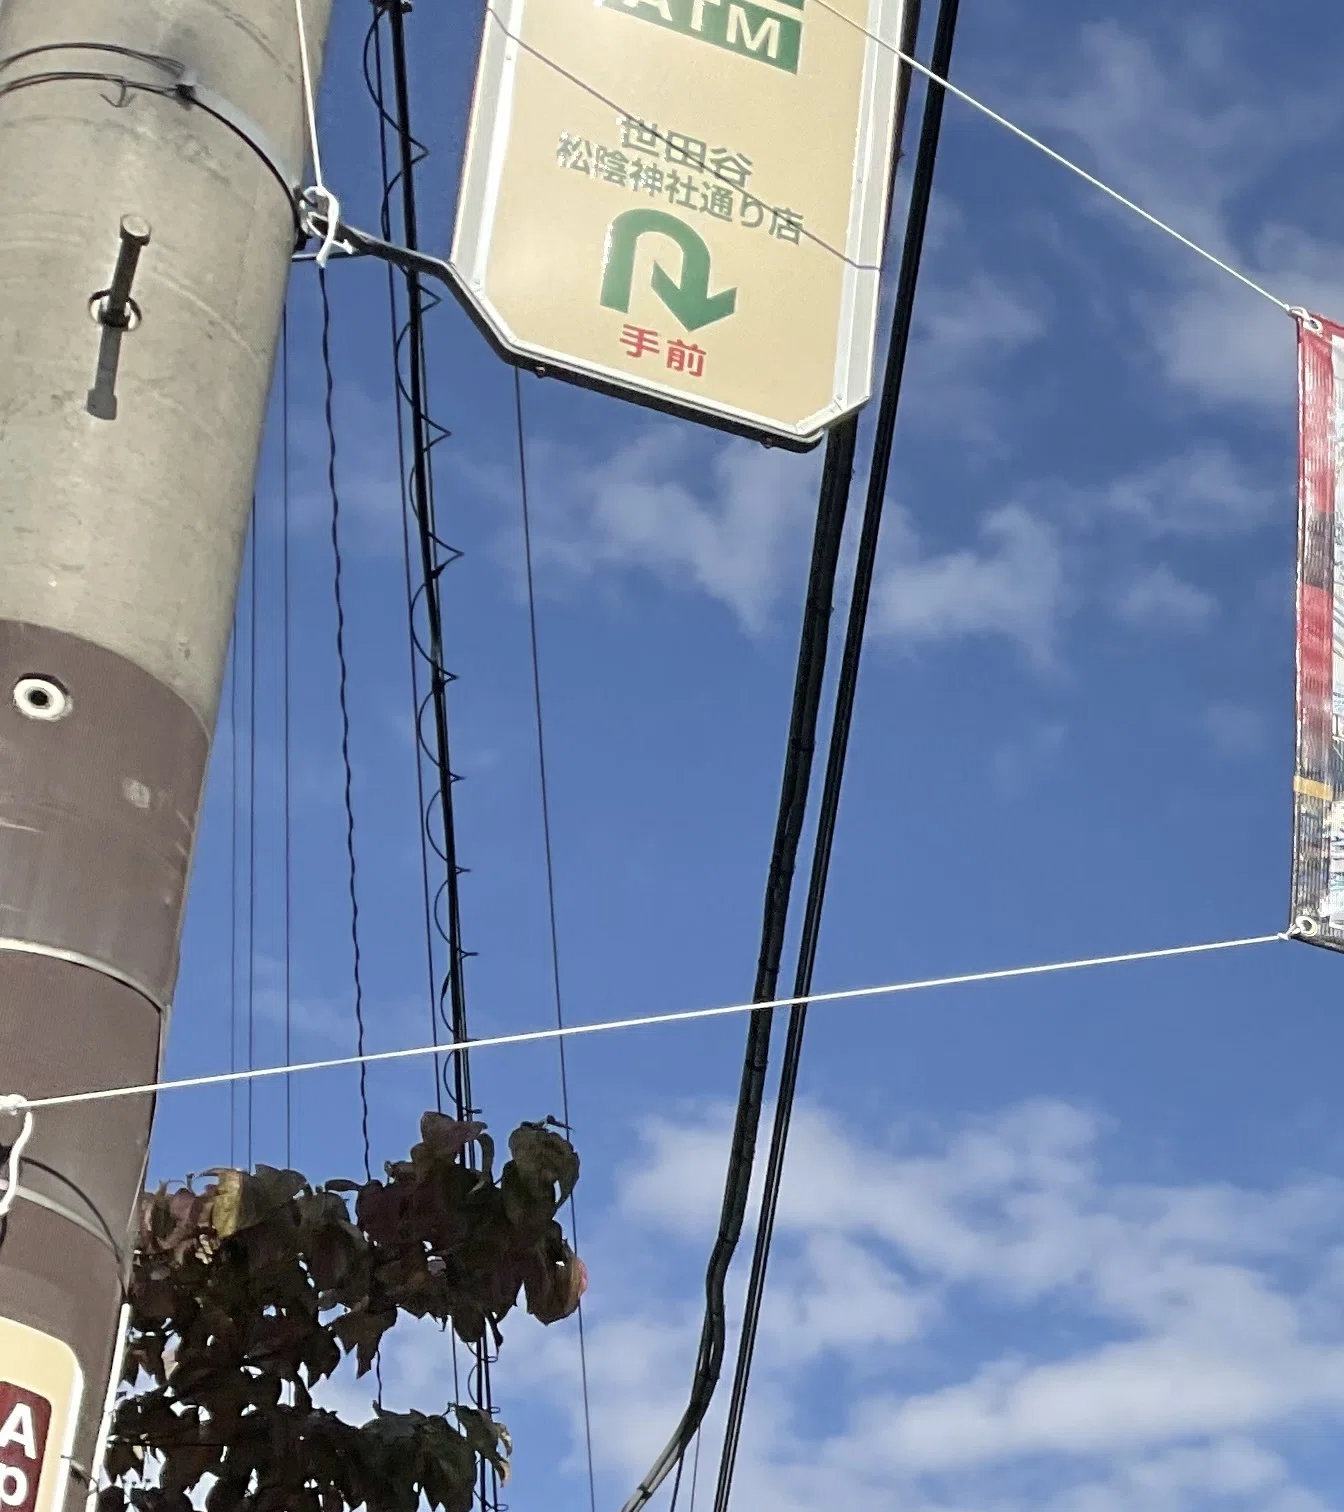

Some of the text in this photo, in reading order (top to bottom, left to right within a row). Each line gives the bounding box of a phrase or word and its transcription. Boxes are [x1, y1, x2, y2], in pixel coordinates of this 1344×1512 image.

[556, 130, 804, 246] 松陰神社通り店
[616, 115, 753, 188] 世田谷
[619, 323, 707, 378] 手前
